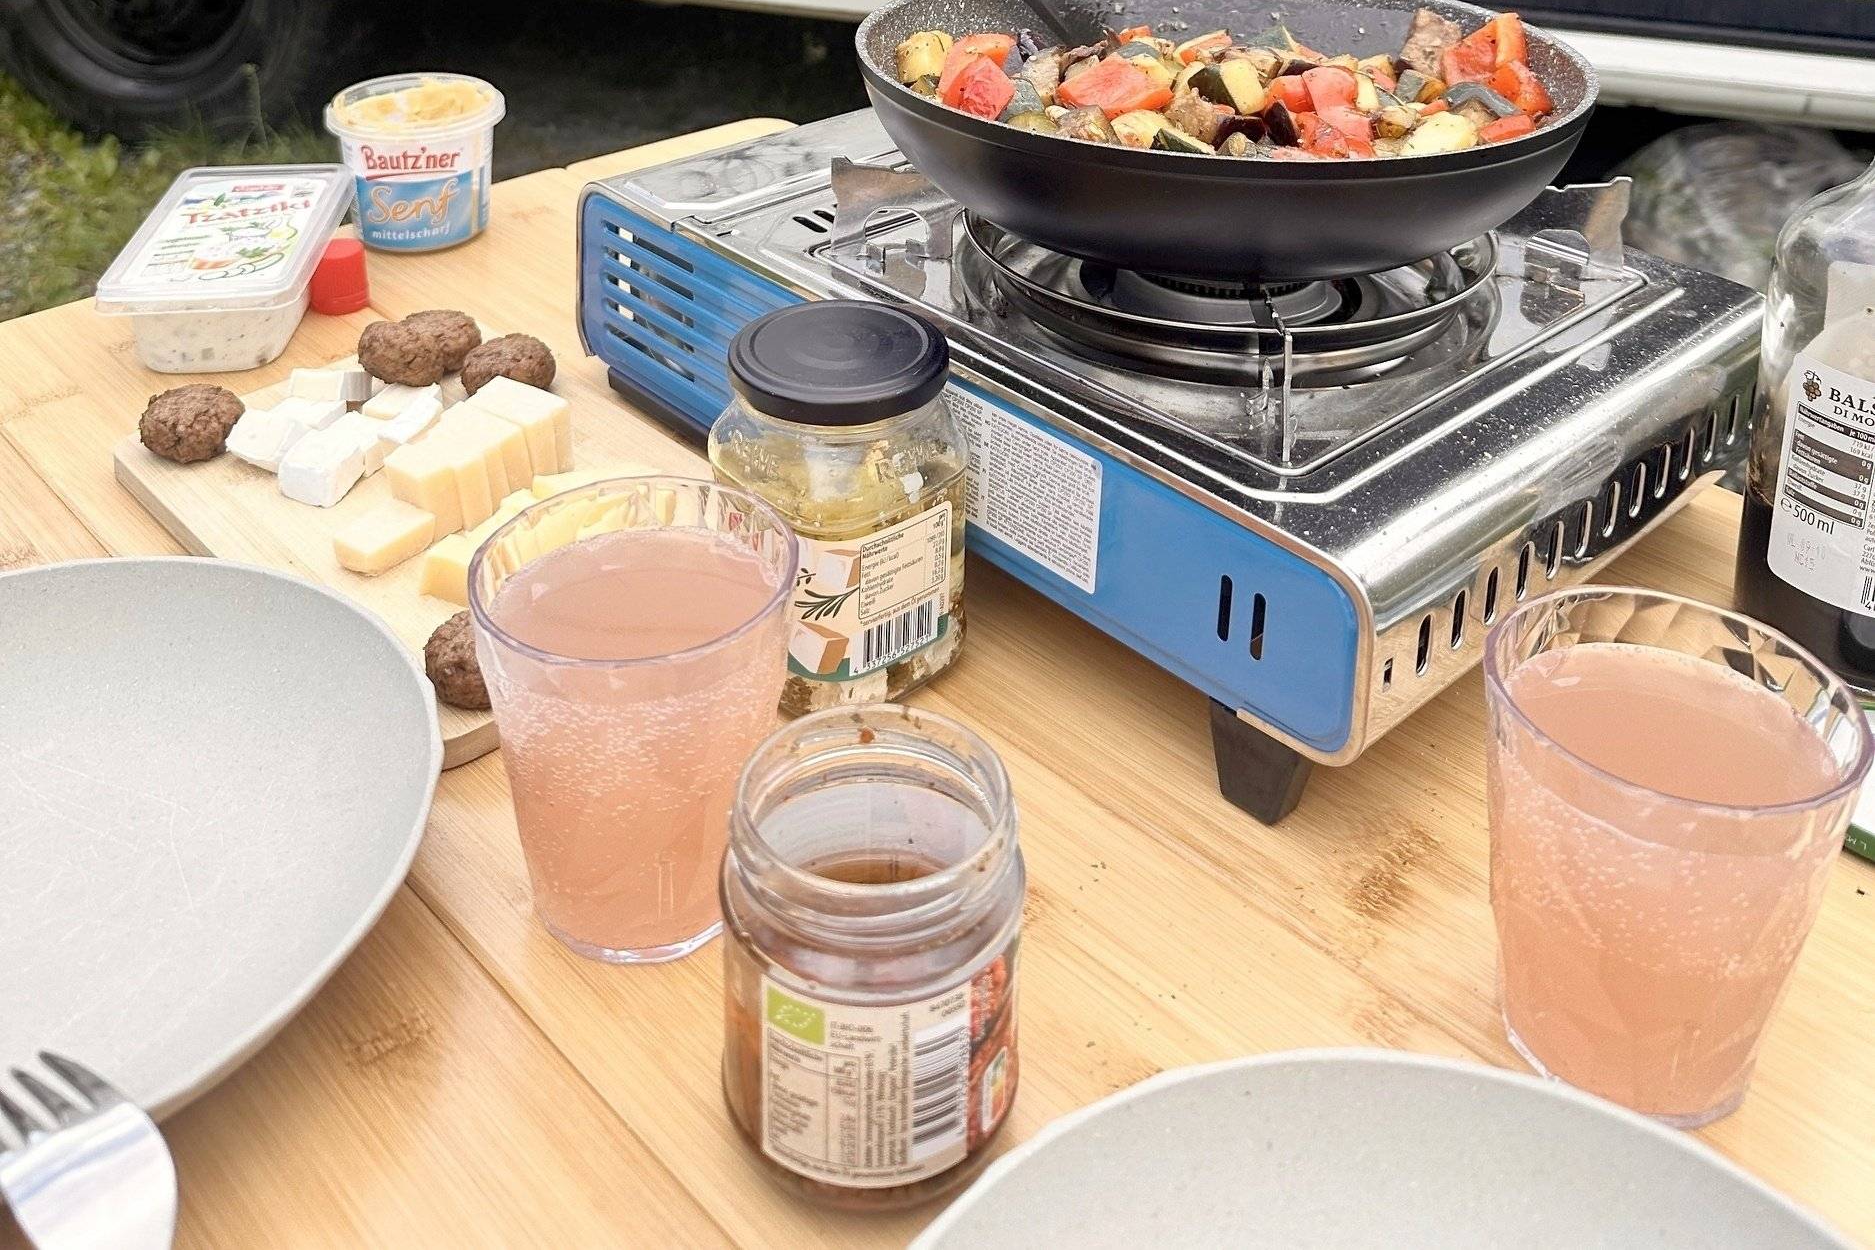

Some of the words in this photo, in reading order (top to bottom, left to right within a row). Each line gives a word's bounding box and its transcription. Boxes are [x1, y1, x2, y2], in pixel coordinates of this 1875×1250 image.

[360, 144, 461, 170] Bautz'ner
[367, 177, 460, 225] Senf
[372, 221, 450, 241] mittelscharf
[1834, 406, 1849, 418] DI
[1851, 413, 1875, 427] MO
[1857, 431, 1868, 440] 100
[1793, 505, 1815, 525] 500
[1817, 519, 1835, 535] ml
